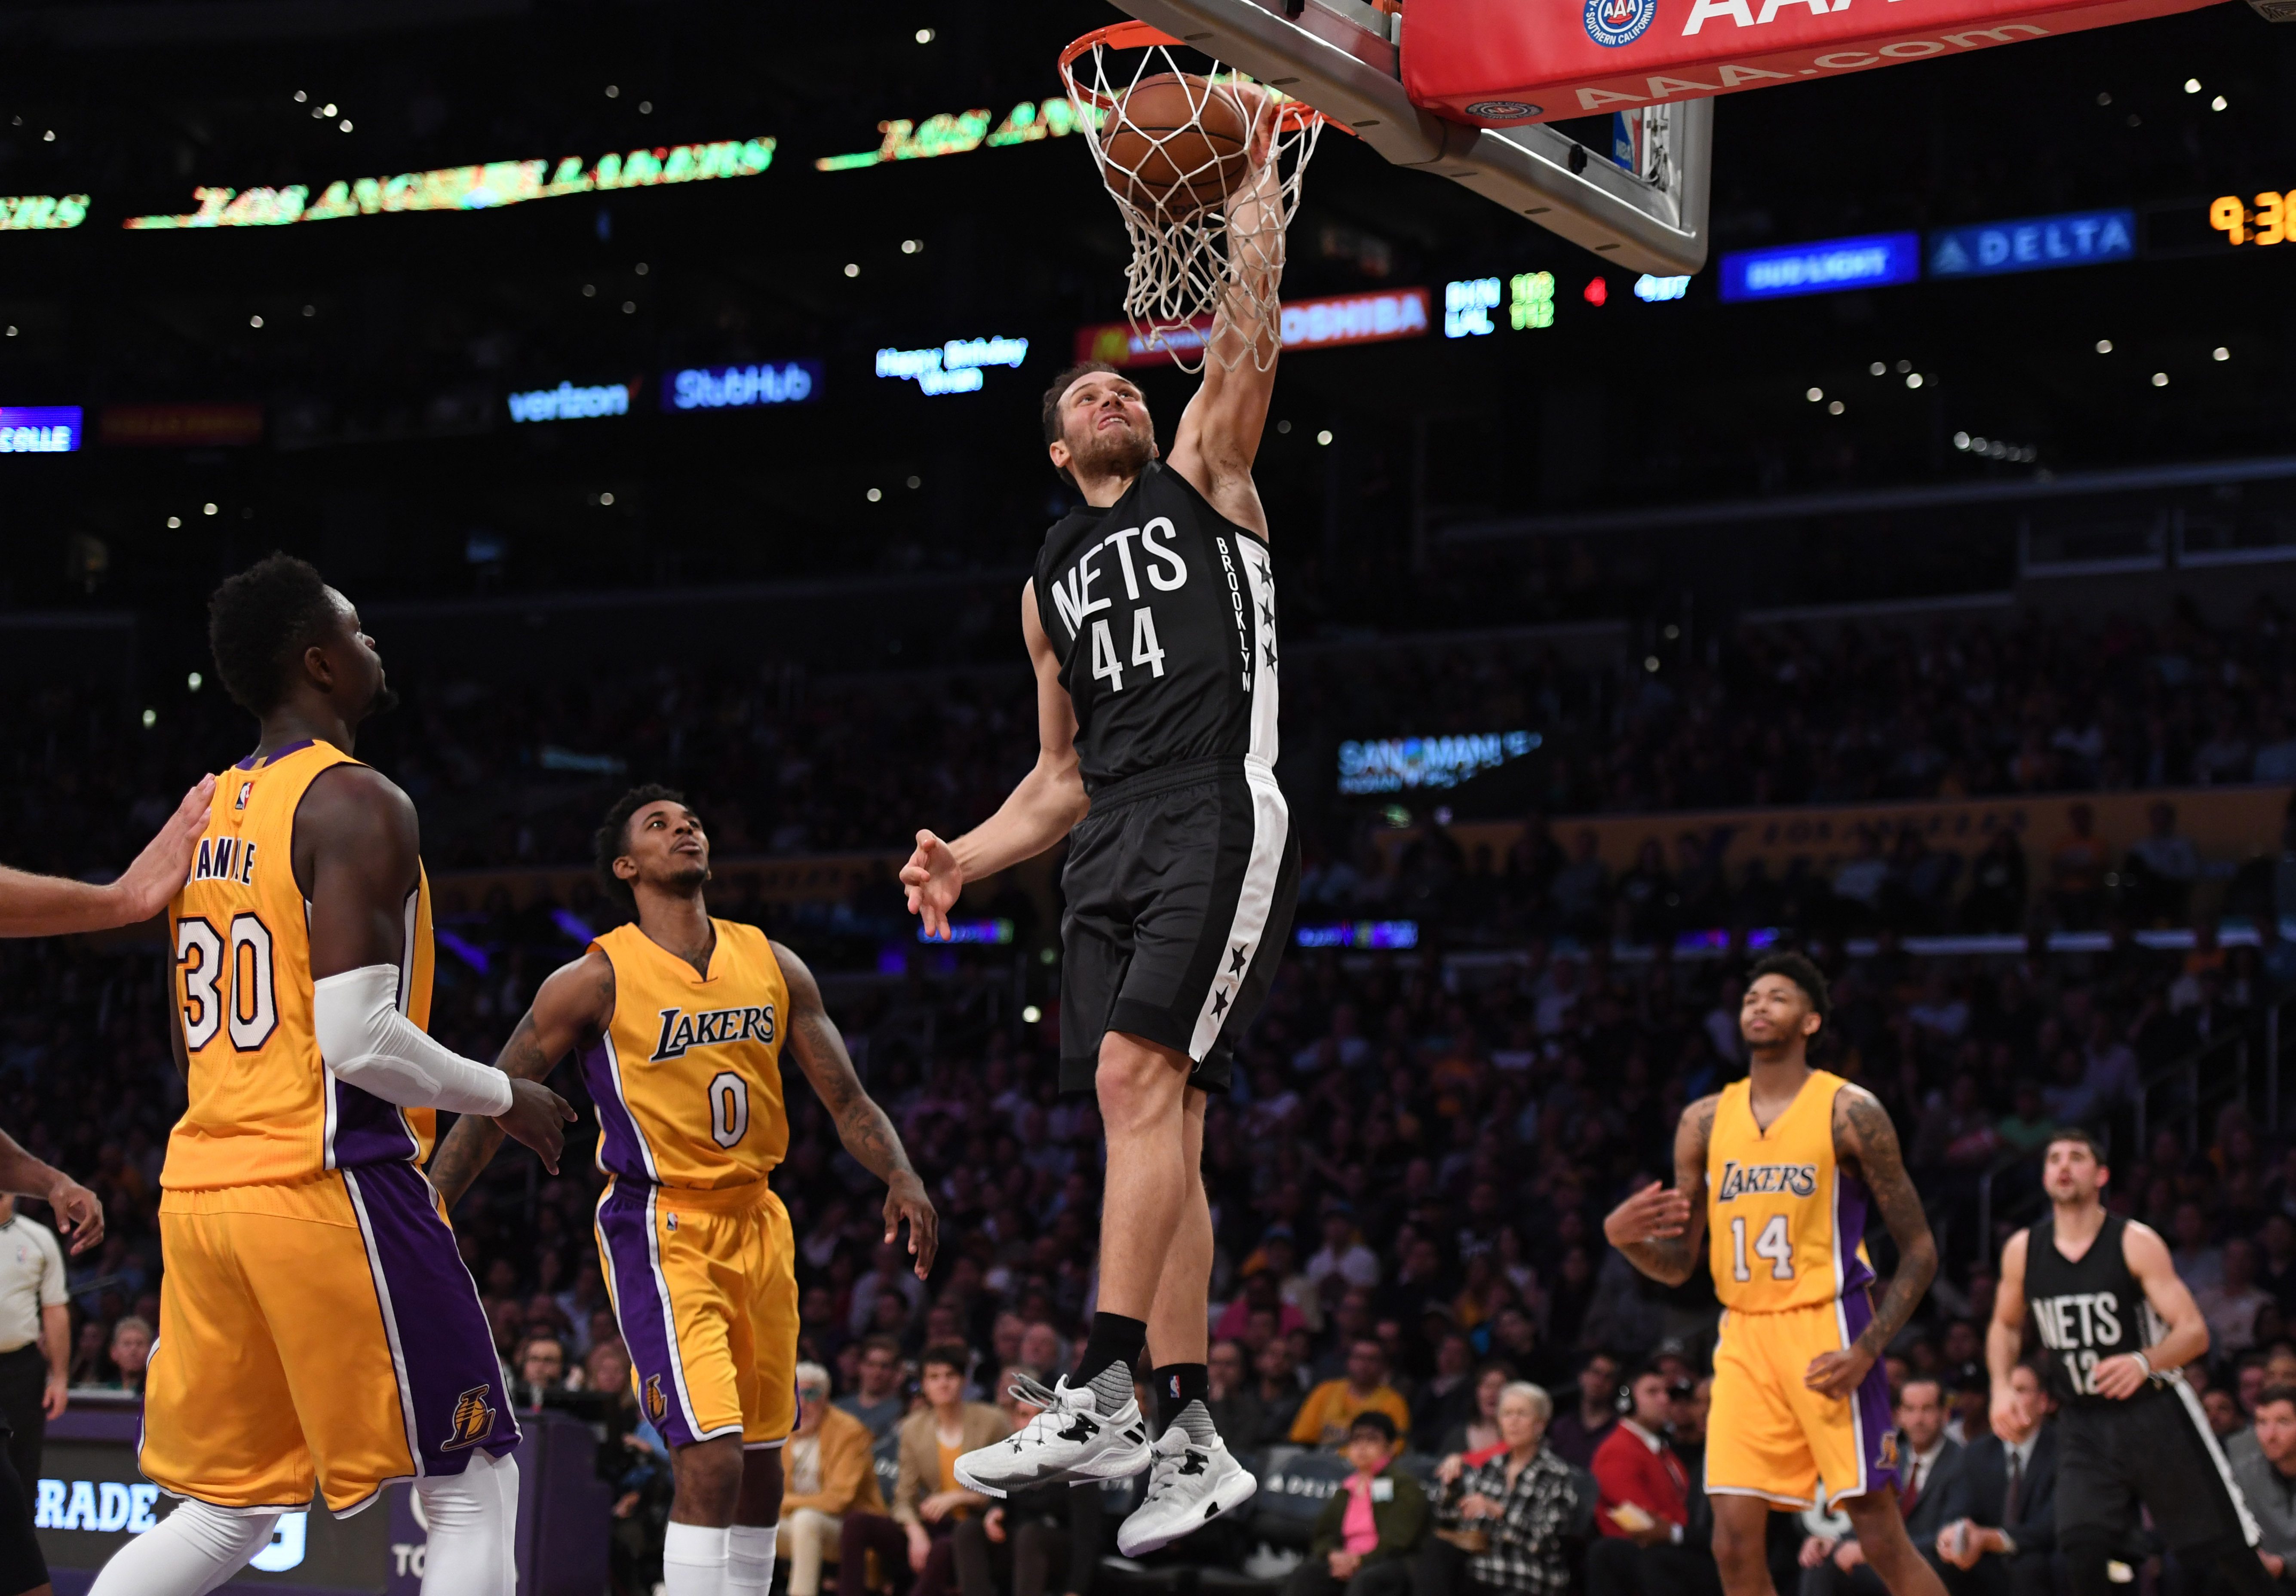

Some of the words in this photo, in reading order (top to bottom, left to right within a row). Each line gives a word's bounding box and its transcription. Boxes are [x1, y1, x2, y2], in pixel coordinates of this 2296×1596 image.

[1586, 12, 1617, 45] SOUTHERN
[1618, 2, 1654, 44] CALIFORNIA
[1575, 24, 2050, 110] AAA.com
[1980, 218, 2133, 266] DELTA
[1281, 294, 1428, 344] OSHIBA
[508, 381, 629, 422] verizon
[674, 361, 812, 409] StubHub
[1052, 517, 1187, 641] NETS
[1216, 537, 1250, 692] BROOKLYN
[1092, 606, 1165, 692] 44
[176, 909, 280, 1053] 30
[649, 1004, 774, 1063] LAKERS
[707, 1070, 749, 1150] 0
[1719, 1159, 1818, 1204] LAKERS
[1731, 1213, 1795, 1282] 14
[2032, 1291, 2122, 1349] NETS
[34, 1479, 160, 1534] RADE
